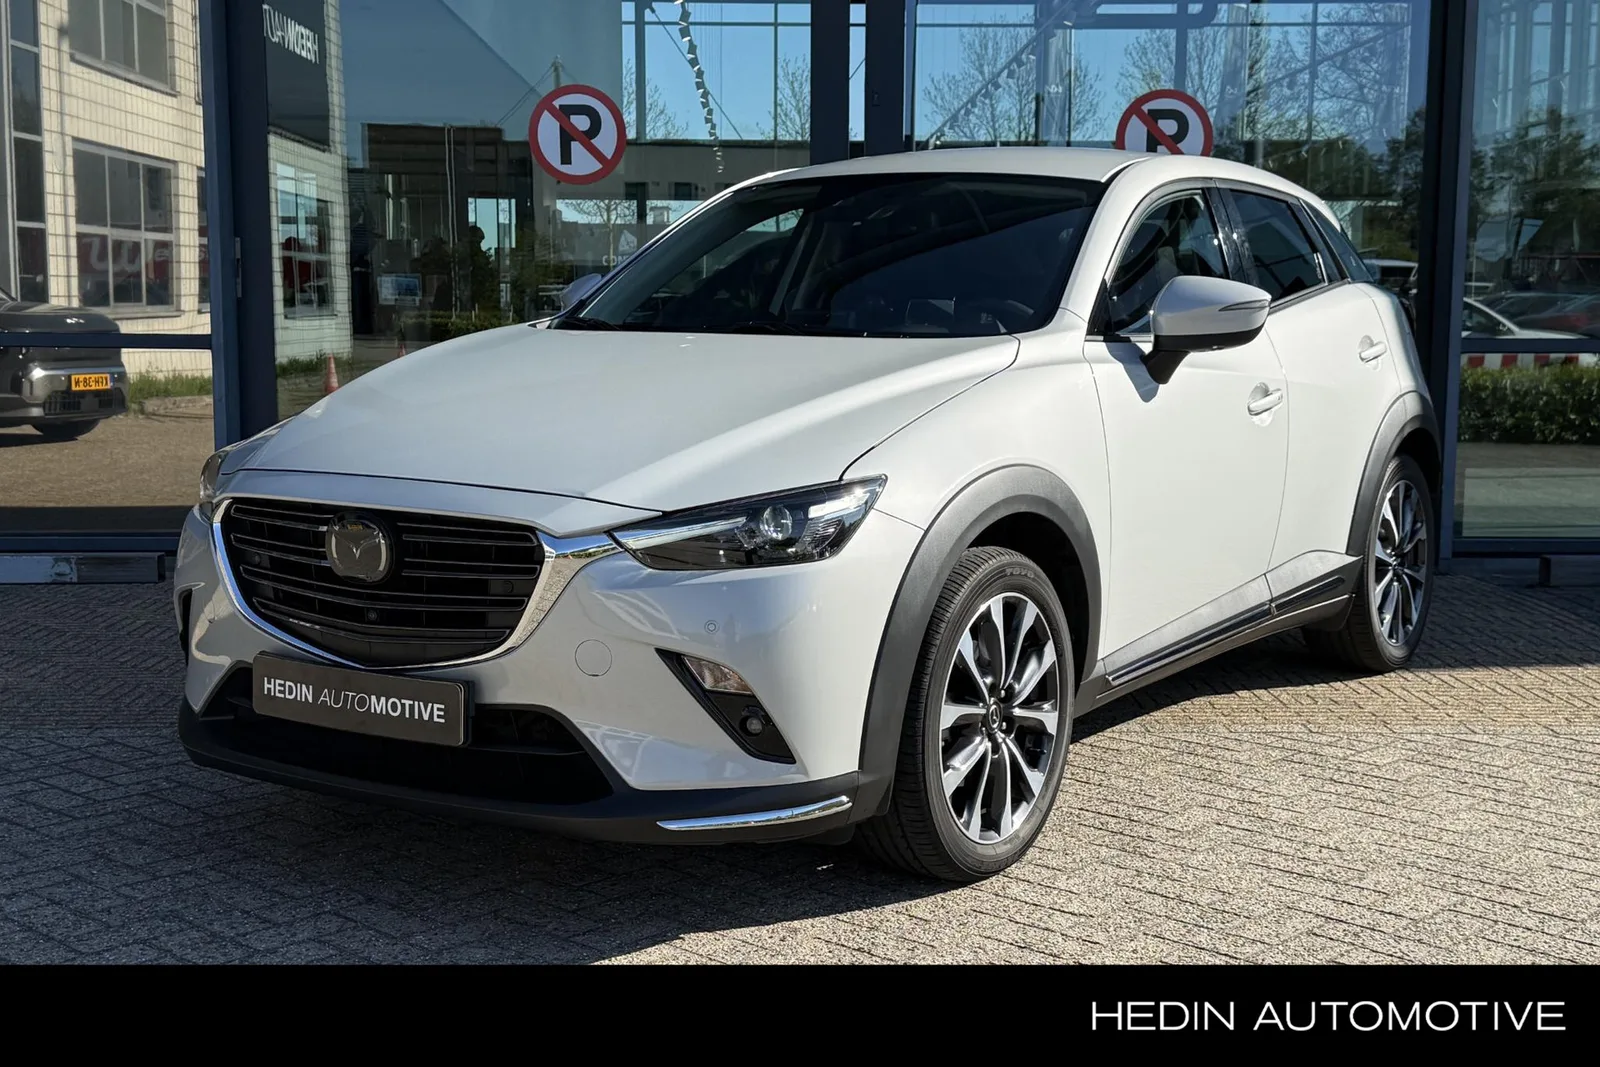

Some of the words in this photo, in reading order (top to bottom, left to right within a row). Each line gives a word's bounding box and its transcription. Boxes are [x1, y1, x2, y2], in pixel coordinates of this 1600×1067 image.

[558, 104, 602, 166] P
[263, 676, 313, 703] HEDIN
[317, 688, 446, 723] AUTOMOTIVE
